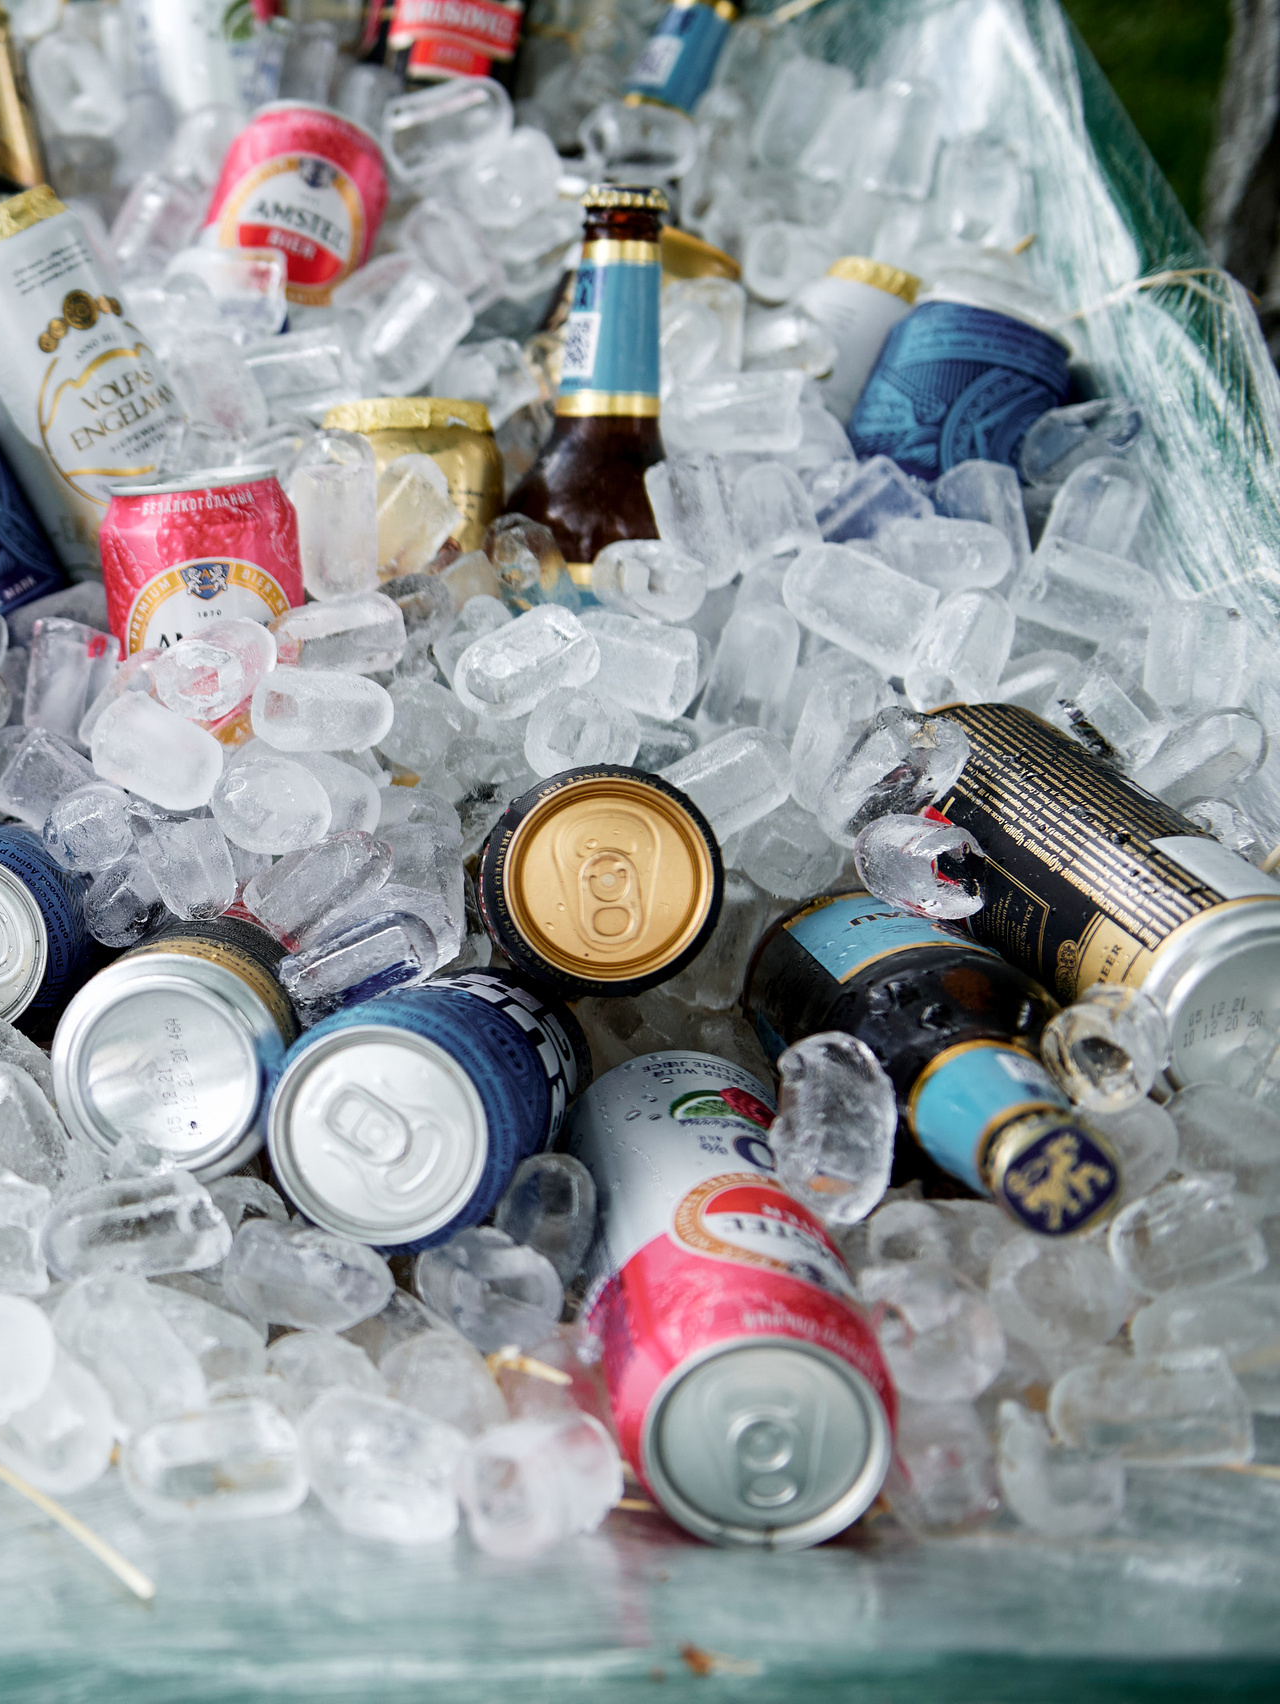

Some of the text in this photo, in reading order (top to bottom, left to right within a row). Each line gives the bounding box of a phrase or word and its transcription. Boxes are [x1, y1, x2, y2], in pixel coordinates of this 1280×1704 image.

[80, 363, 153, 414] VOLFAS
[141, 488, 255, 517] БЕЗАЛКОГОЛЬНЫЙ
[241, 567, 274, 597] BIER
[130, 578, 172, 642] PREMIUM
[197, 609, 223, 618] 1870
[568, 771, 609, 785] SINCE
[611, 771, 657, 789] KINGS
[8, 849, 40, 875] Aging
[493, 829, 514, 885] BREWED
[25, 878, 56, 910] brewer
[496, 892, 508, 916] FOR
[1059, 865, 1120, 914] пастеризованное
[53, 909, 69, 939] other
[504, 919, 532, 958] KINGS
[54, 945, 65, 970] This
[692, 1061, 731, 1077] LIME
